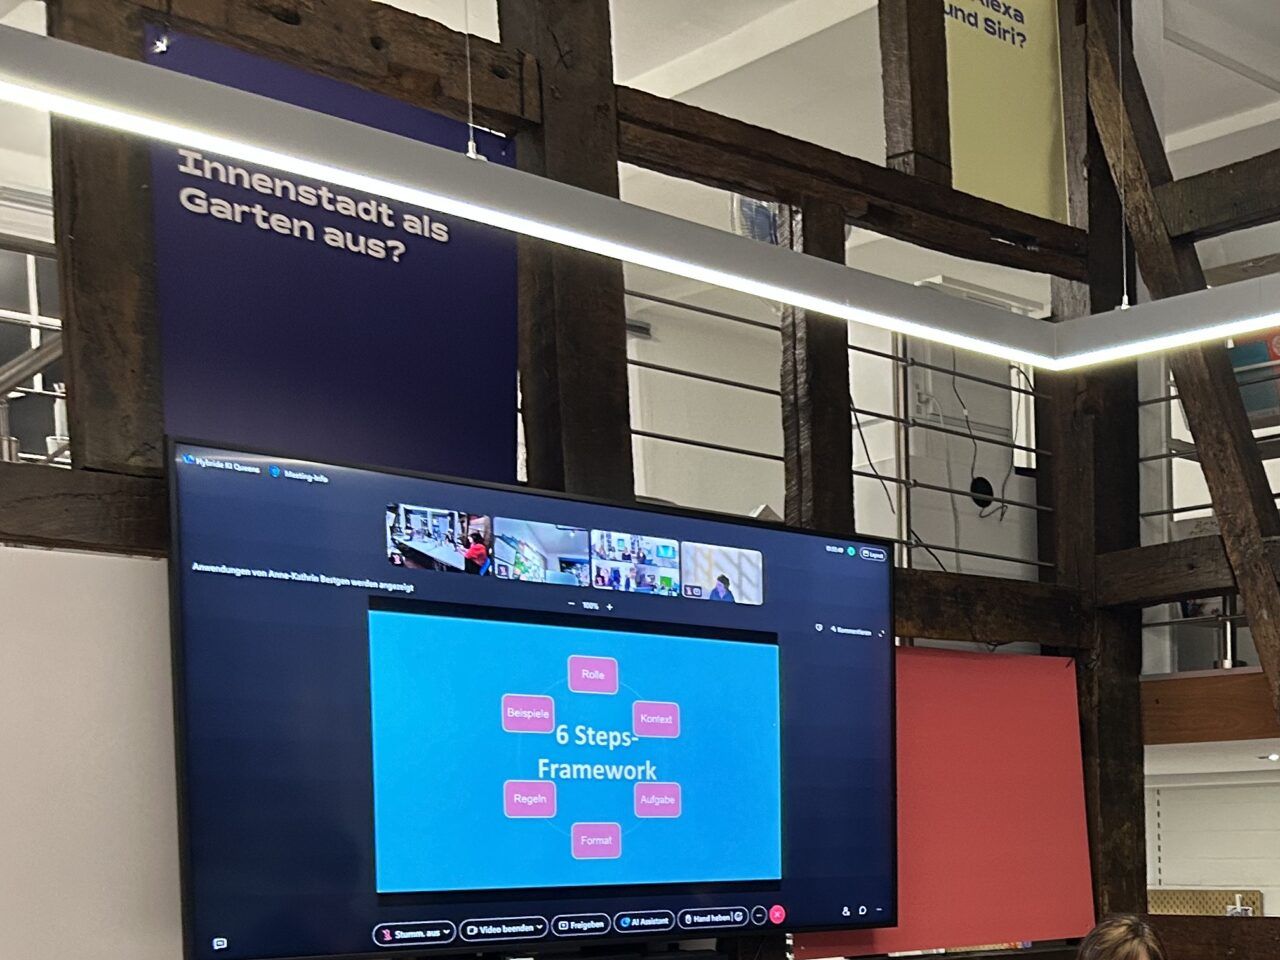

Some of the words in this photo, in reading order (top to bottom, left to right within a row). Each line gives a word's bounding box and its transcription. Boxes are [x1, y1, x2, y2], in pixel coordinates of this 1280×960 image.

[944, 4, 978, 28] und
[984, 17, 1026, 48] Siri?
[178, 149, 395, 227] Innenstadt
[403, 214, 449, 243] als
[179, 187, 315, 241] Garten
[323, 226, 406, 263] aus?
[192, 562, 252, 577] Anwendungen
[252, 569, 267, 578] von
[268, 569, 319, 584] Anne-Kathrin
[350, 578, 379, 589] werden
[581, 668, 605, 680] Rolle
[507, 707, 549, 720] Beispiele
[640, 714, 673, 724] Kontext
[556, 724, 569, 745] 6
[575, 725, 639, 750] Steps-
[538, 758, 657, 780] Framework
[513, 793, 547, 806] Regeln
[640, 795, 676, 806] Aufgabe
[580, 835, 612, 846] Format
[694, 914, 710, 923] Hand
[711, 913, 731, 922] heben
[479, 925, 502, 935] Video
[503, 924, 534, 934] beenden
[570, 920, 605, 931] Freigeben
